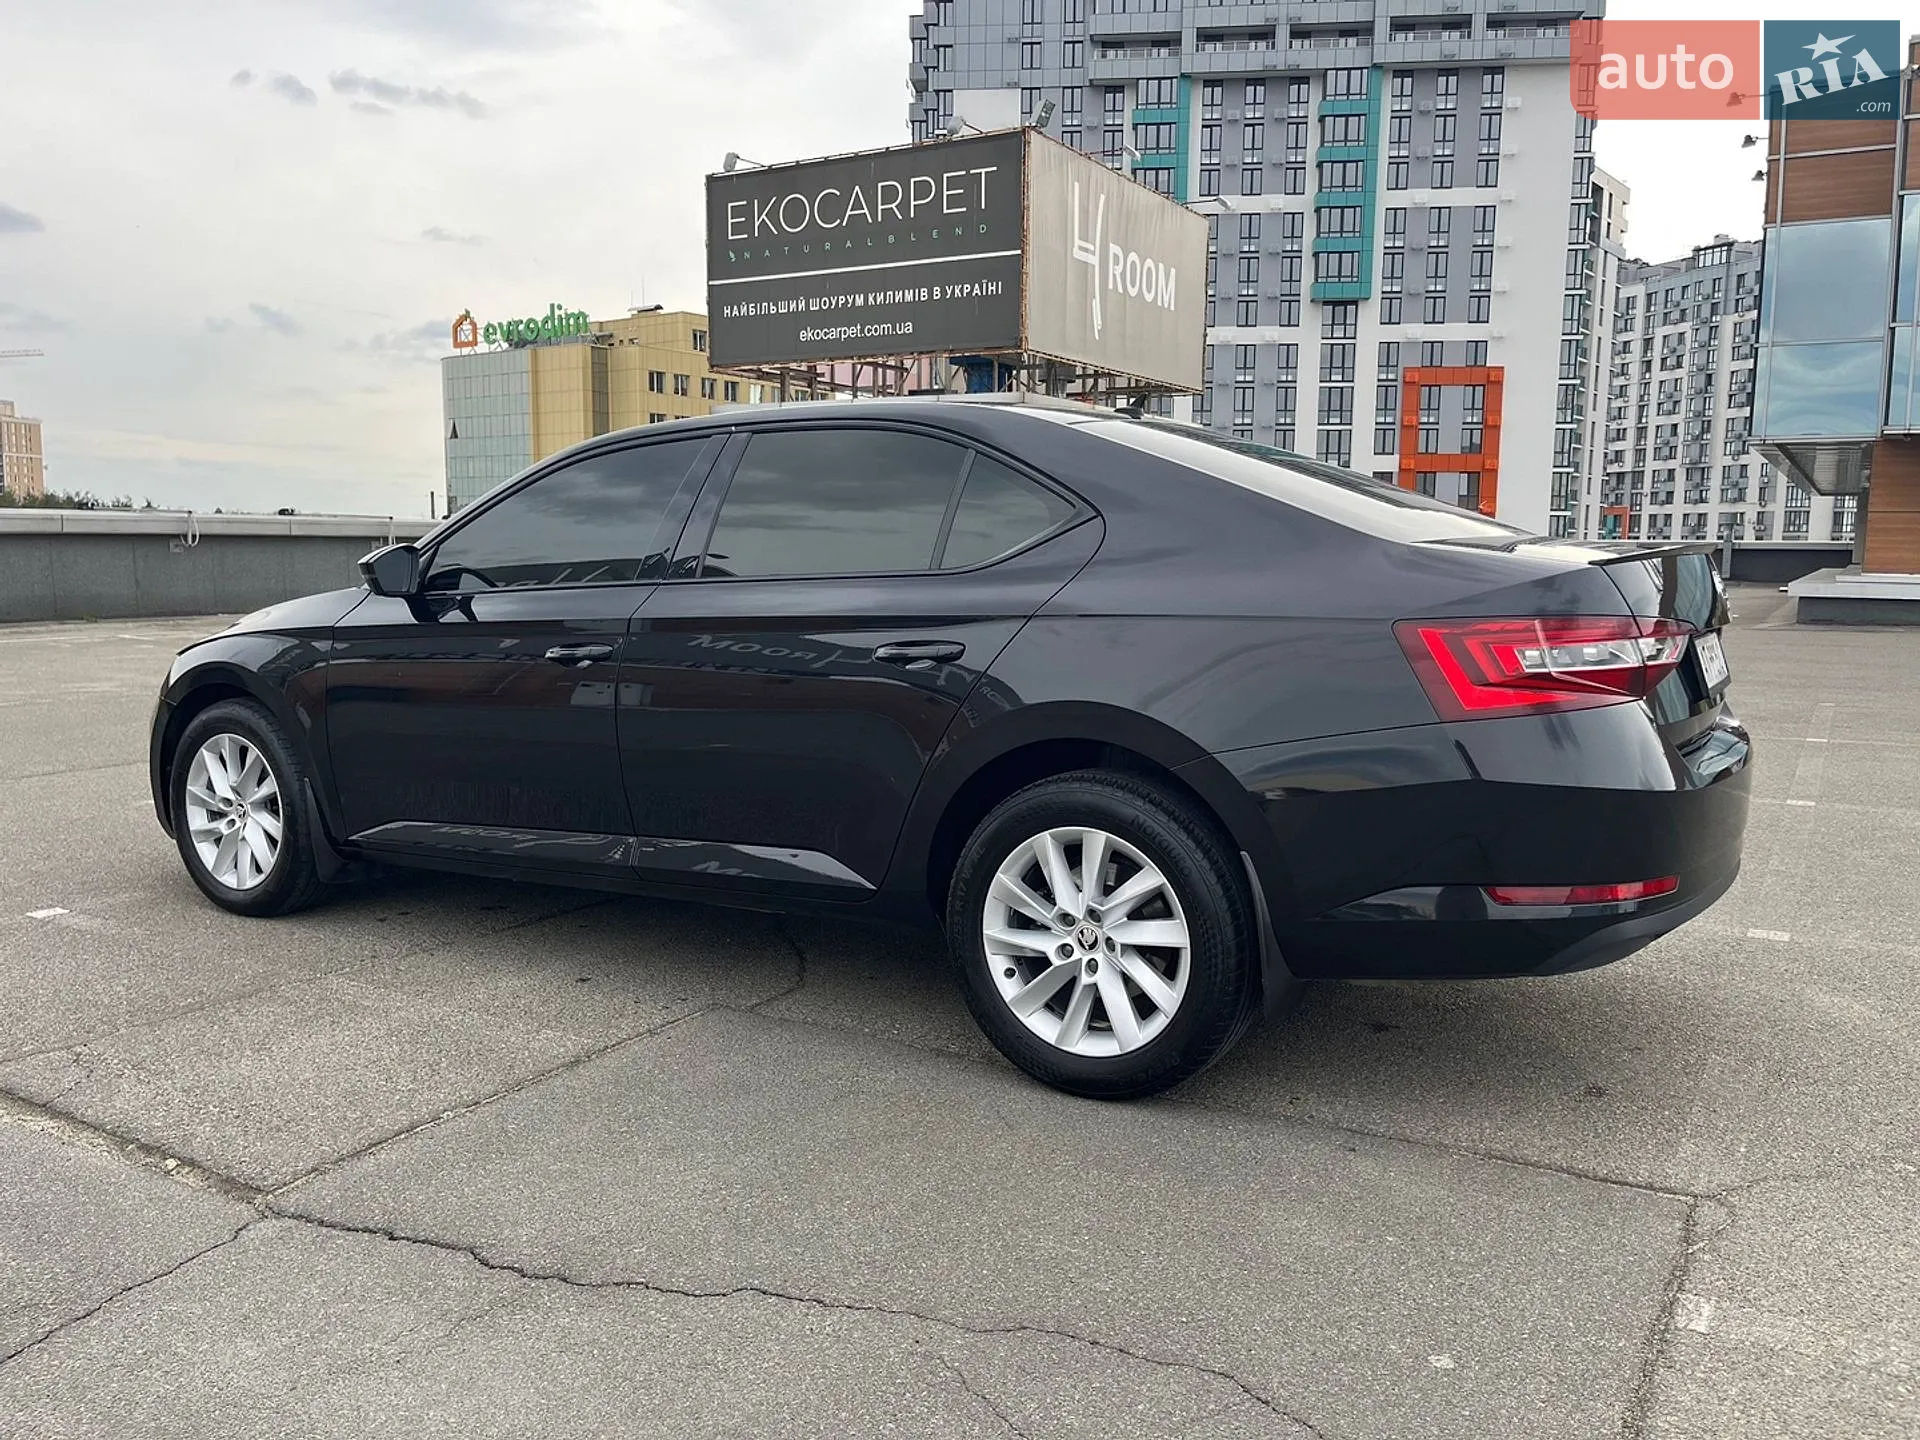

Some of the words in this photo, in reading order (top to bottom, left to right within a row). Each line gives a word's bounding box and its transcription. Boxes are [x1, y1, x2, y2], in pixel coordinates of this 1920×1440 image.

[728, 167, 998, 240] EKOCARPET
[1108, 242, 1176, 311] ROOM
[723, 297, 806, 318] НАЙБІЛЬШИЙ
[809, 293, 864, 311] ШОУРУМ
[868, 287, 928, 306] КИЛИМІВ
[933, 286, 941, 300] В
[945, 279, 1003, 299] УКРАЇНІ
[483, 303, 589, 345] evrodim
[799, 321, 913, 342] ekocarpet.com.ua
